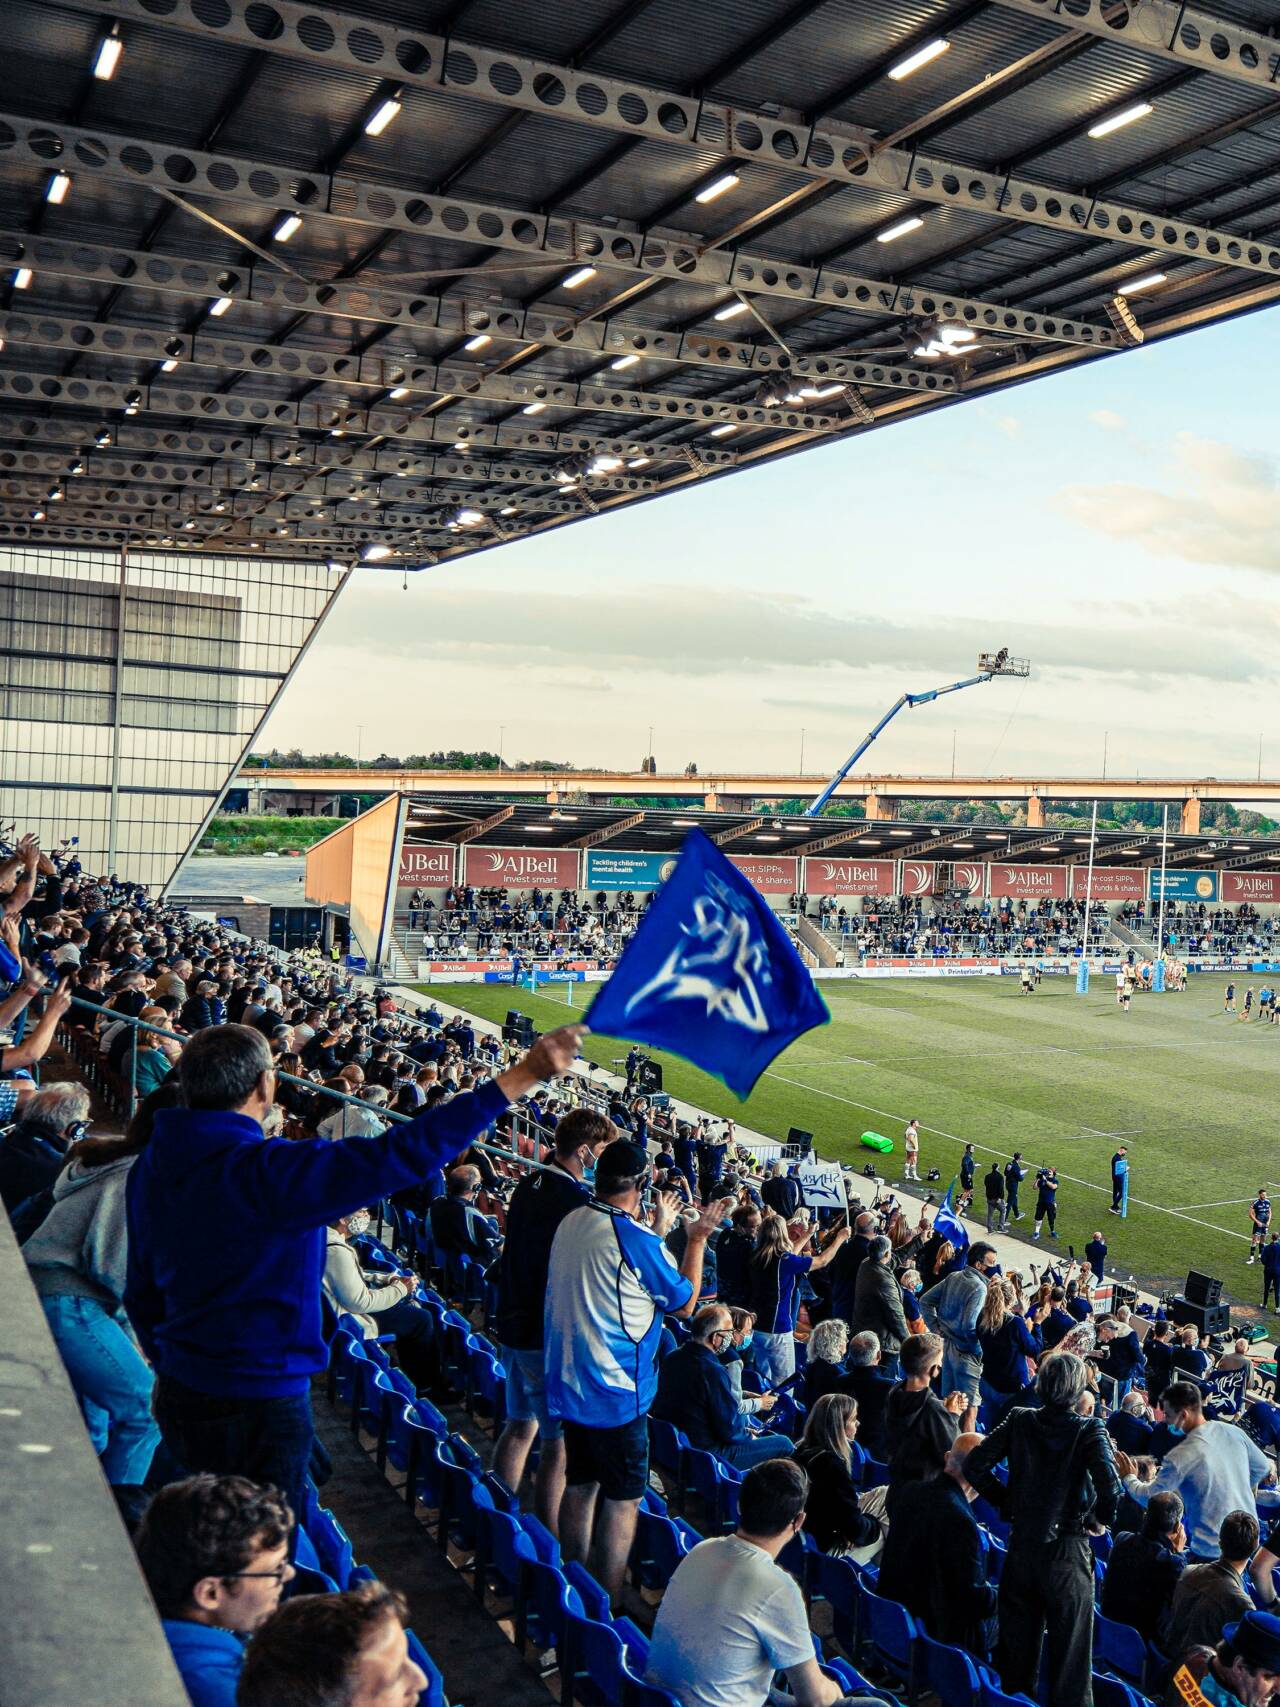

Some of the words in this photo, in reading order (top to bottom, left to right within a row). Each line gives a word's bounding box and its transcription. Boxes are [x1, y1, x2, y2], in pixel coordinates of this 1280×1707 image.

[421, 874, 449, 882] smart
[503, 875, 530, 883] Invest
[532, 876, 558, 884] smart
[765, 876, 793, 885] shares
